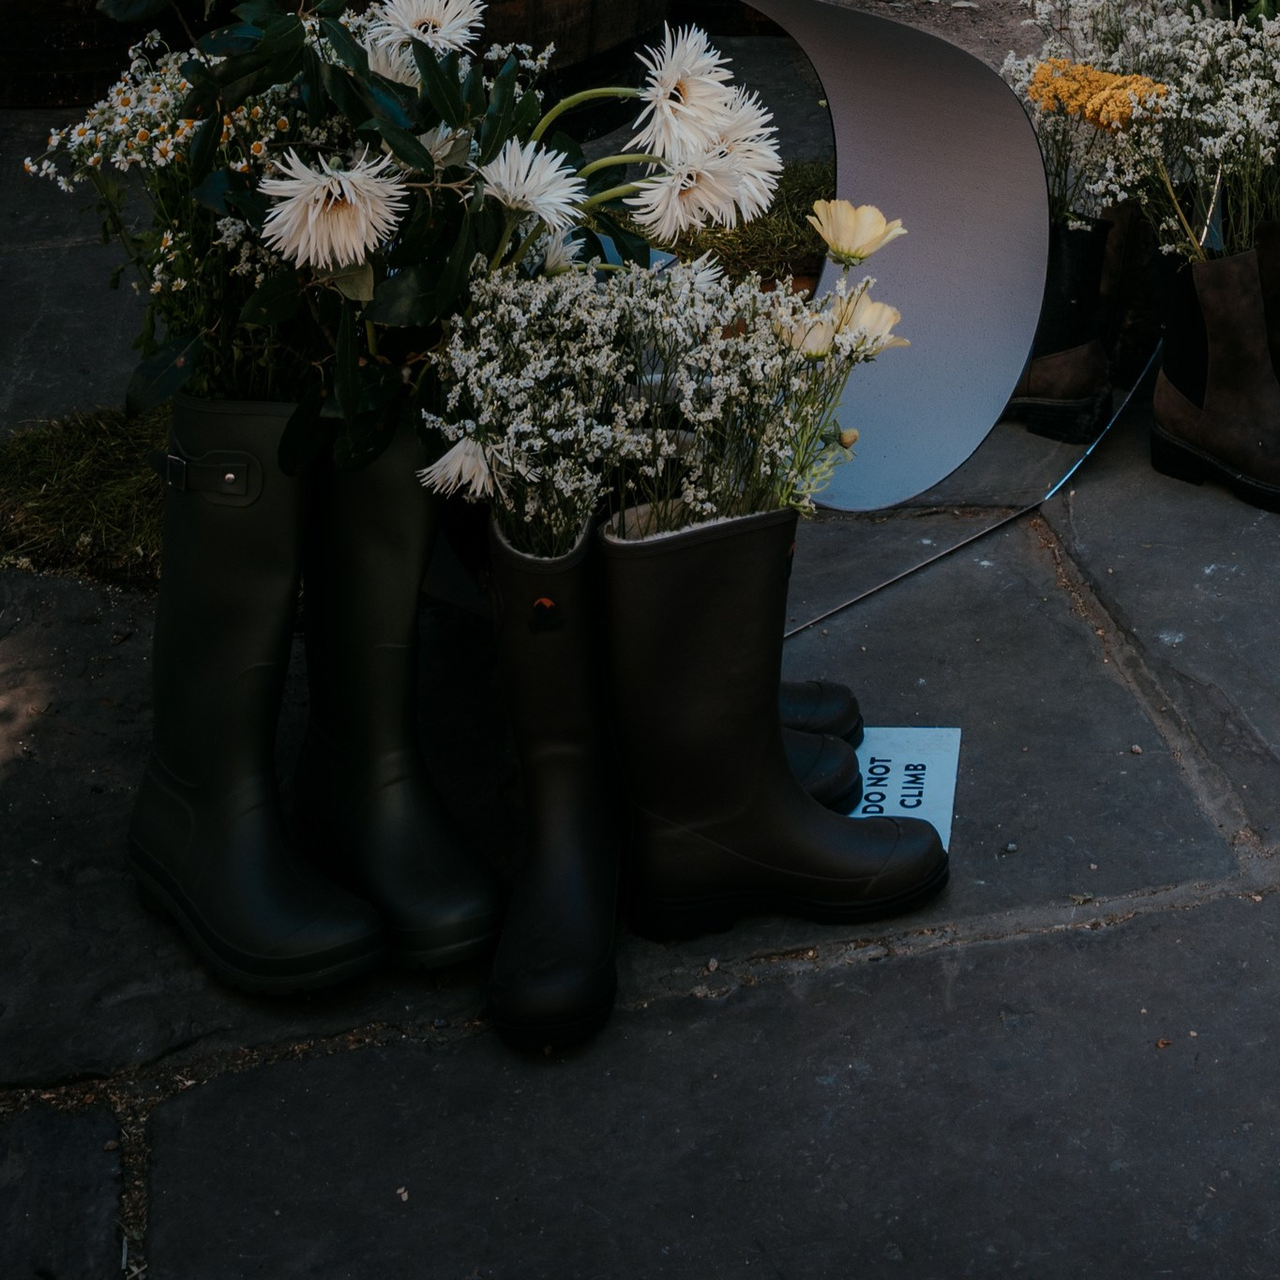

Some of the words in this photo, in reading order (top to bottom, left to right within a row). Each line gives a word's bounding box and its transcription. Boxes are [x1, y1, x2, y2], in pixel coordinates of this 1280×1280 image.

[866, 757, 892, 787] NOT
[899, 763, 926, 809] CLIMB
[861, 791, 886, 814] DO
